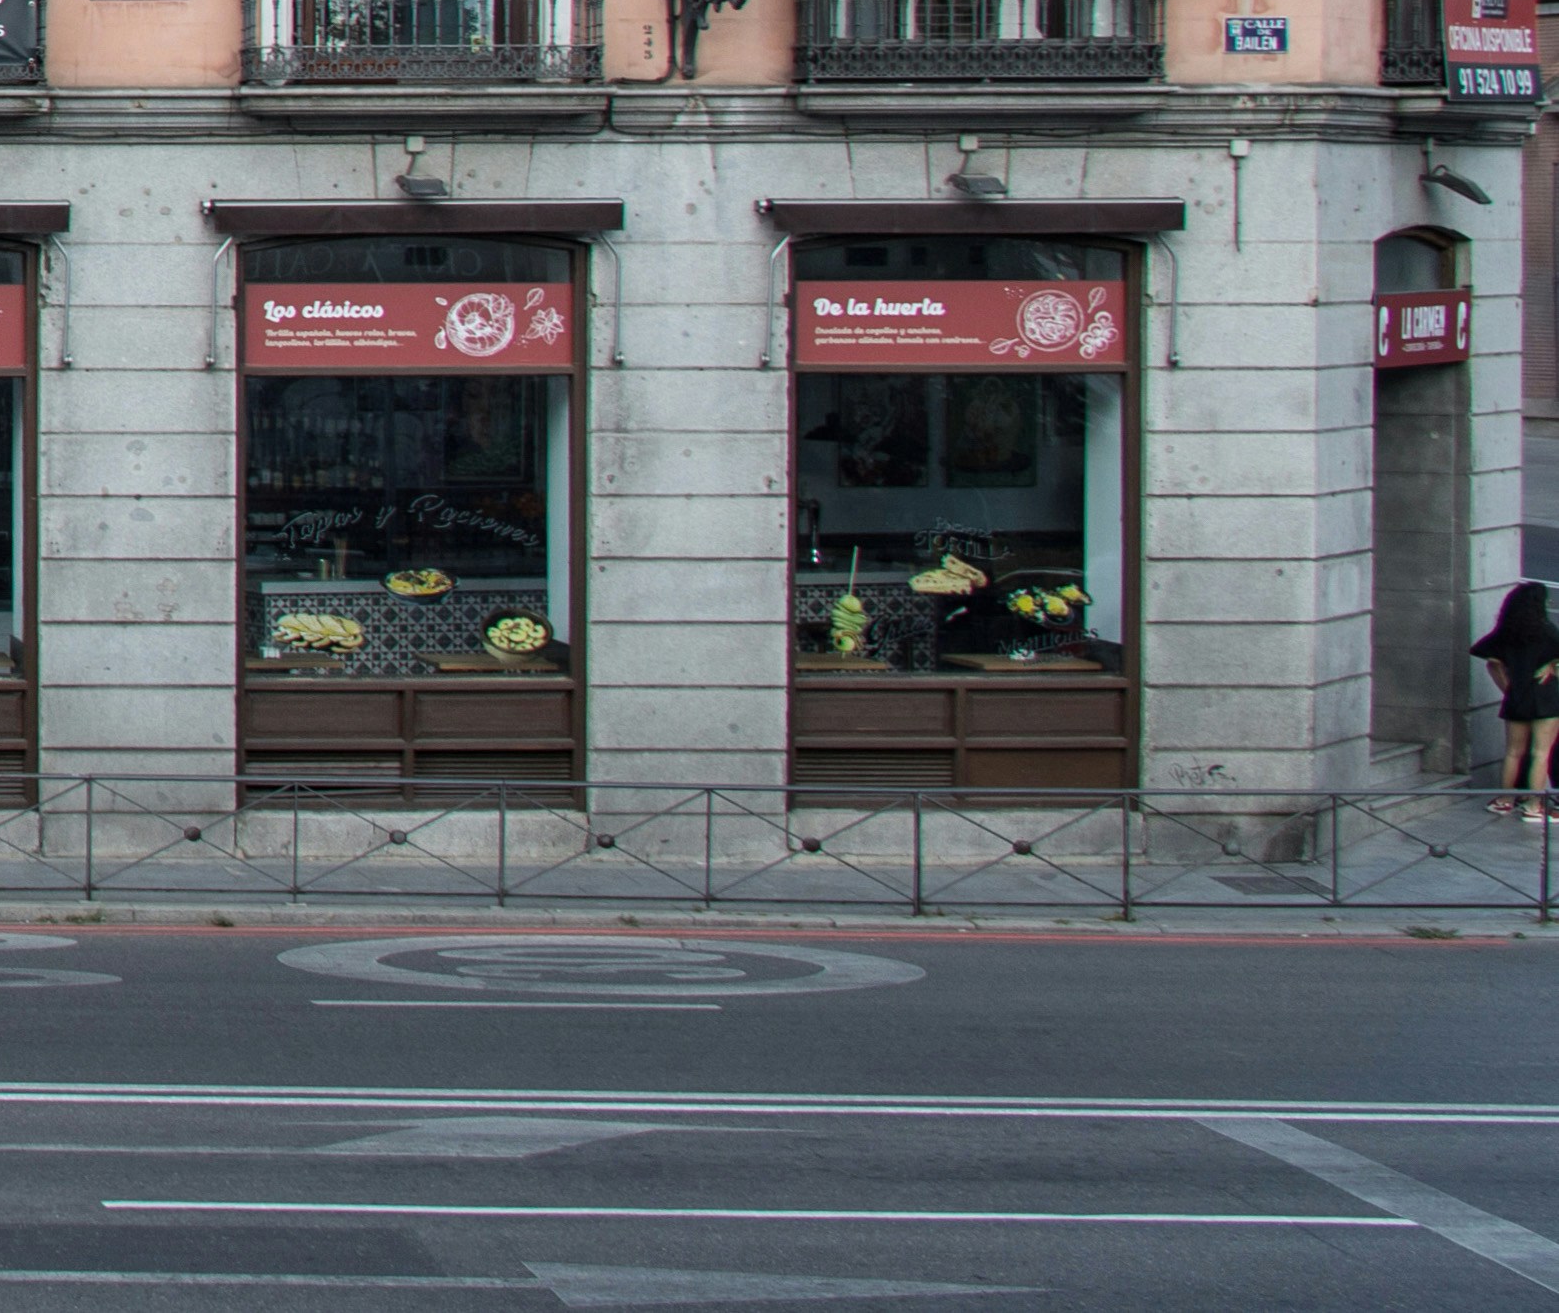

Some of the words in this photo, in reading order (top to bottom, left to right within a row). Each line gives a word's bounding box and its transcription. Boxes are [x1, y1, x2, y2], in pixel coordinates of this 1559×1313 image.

[1244, 19, 1285, 29] CALLE
[1449, 26, 1481, 51] OFICINA
[1482, 27, 1533, 53] DISPONIBLE
[1458, 68, 1474, 95] 91
[1476, 68, 1500, 95] 524
[1500, 69, 1517, 95] 10
[1517, 69, 1533, 96] 99
[263, 300, 296, 323] Los
[302, 300, 384, 318] clásicos
[813, 298, 844, 316] De
[847, 298, 871, 316] la
[874, 298, 946, 316] huerta
